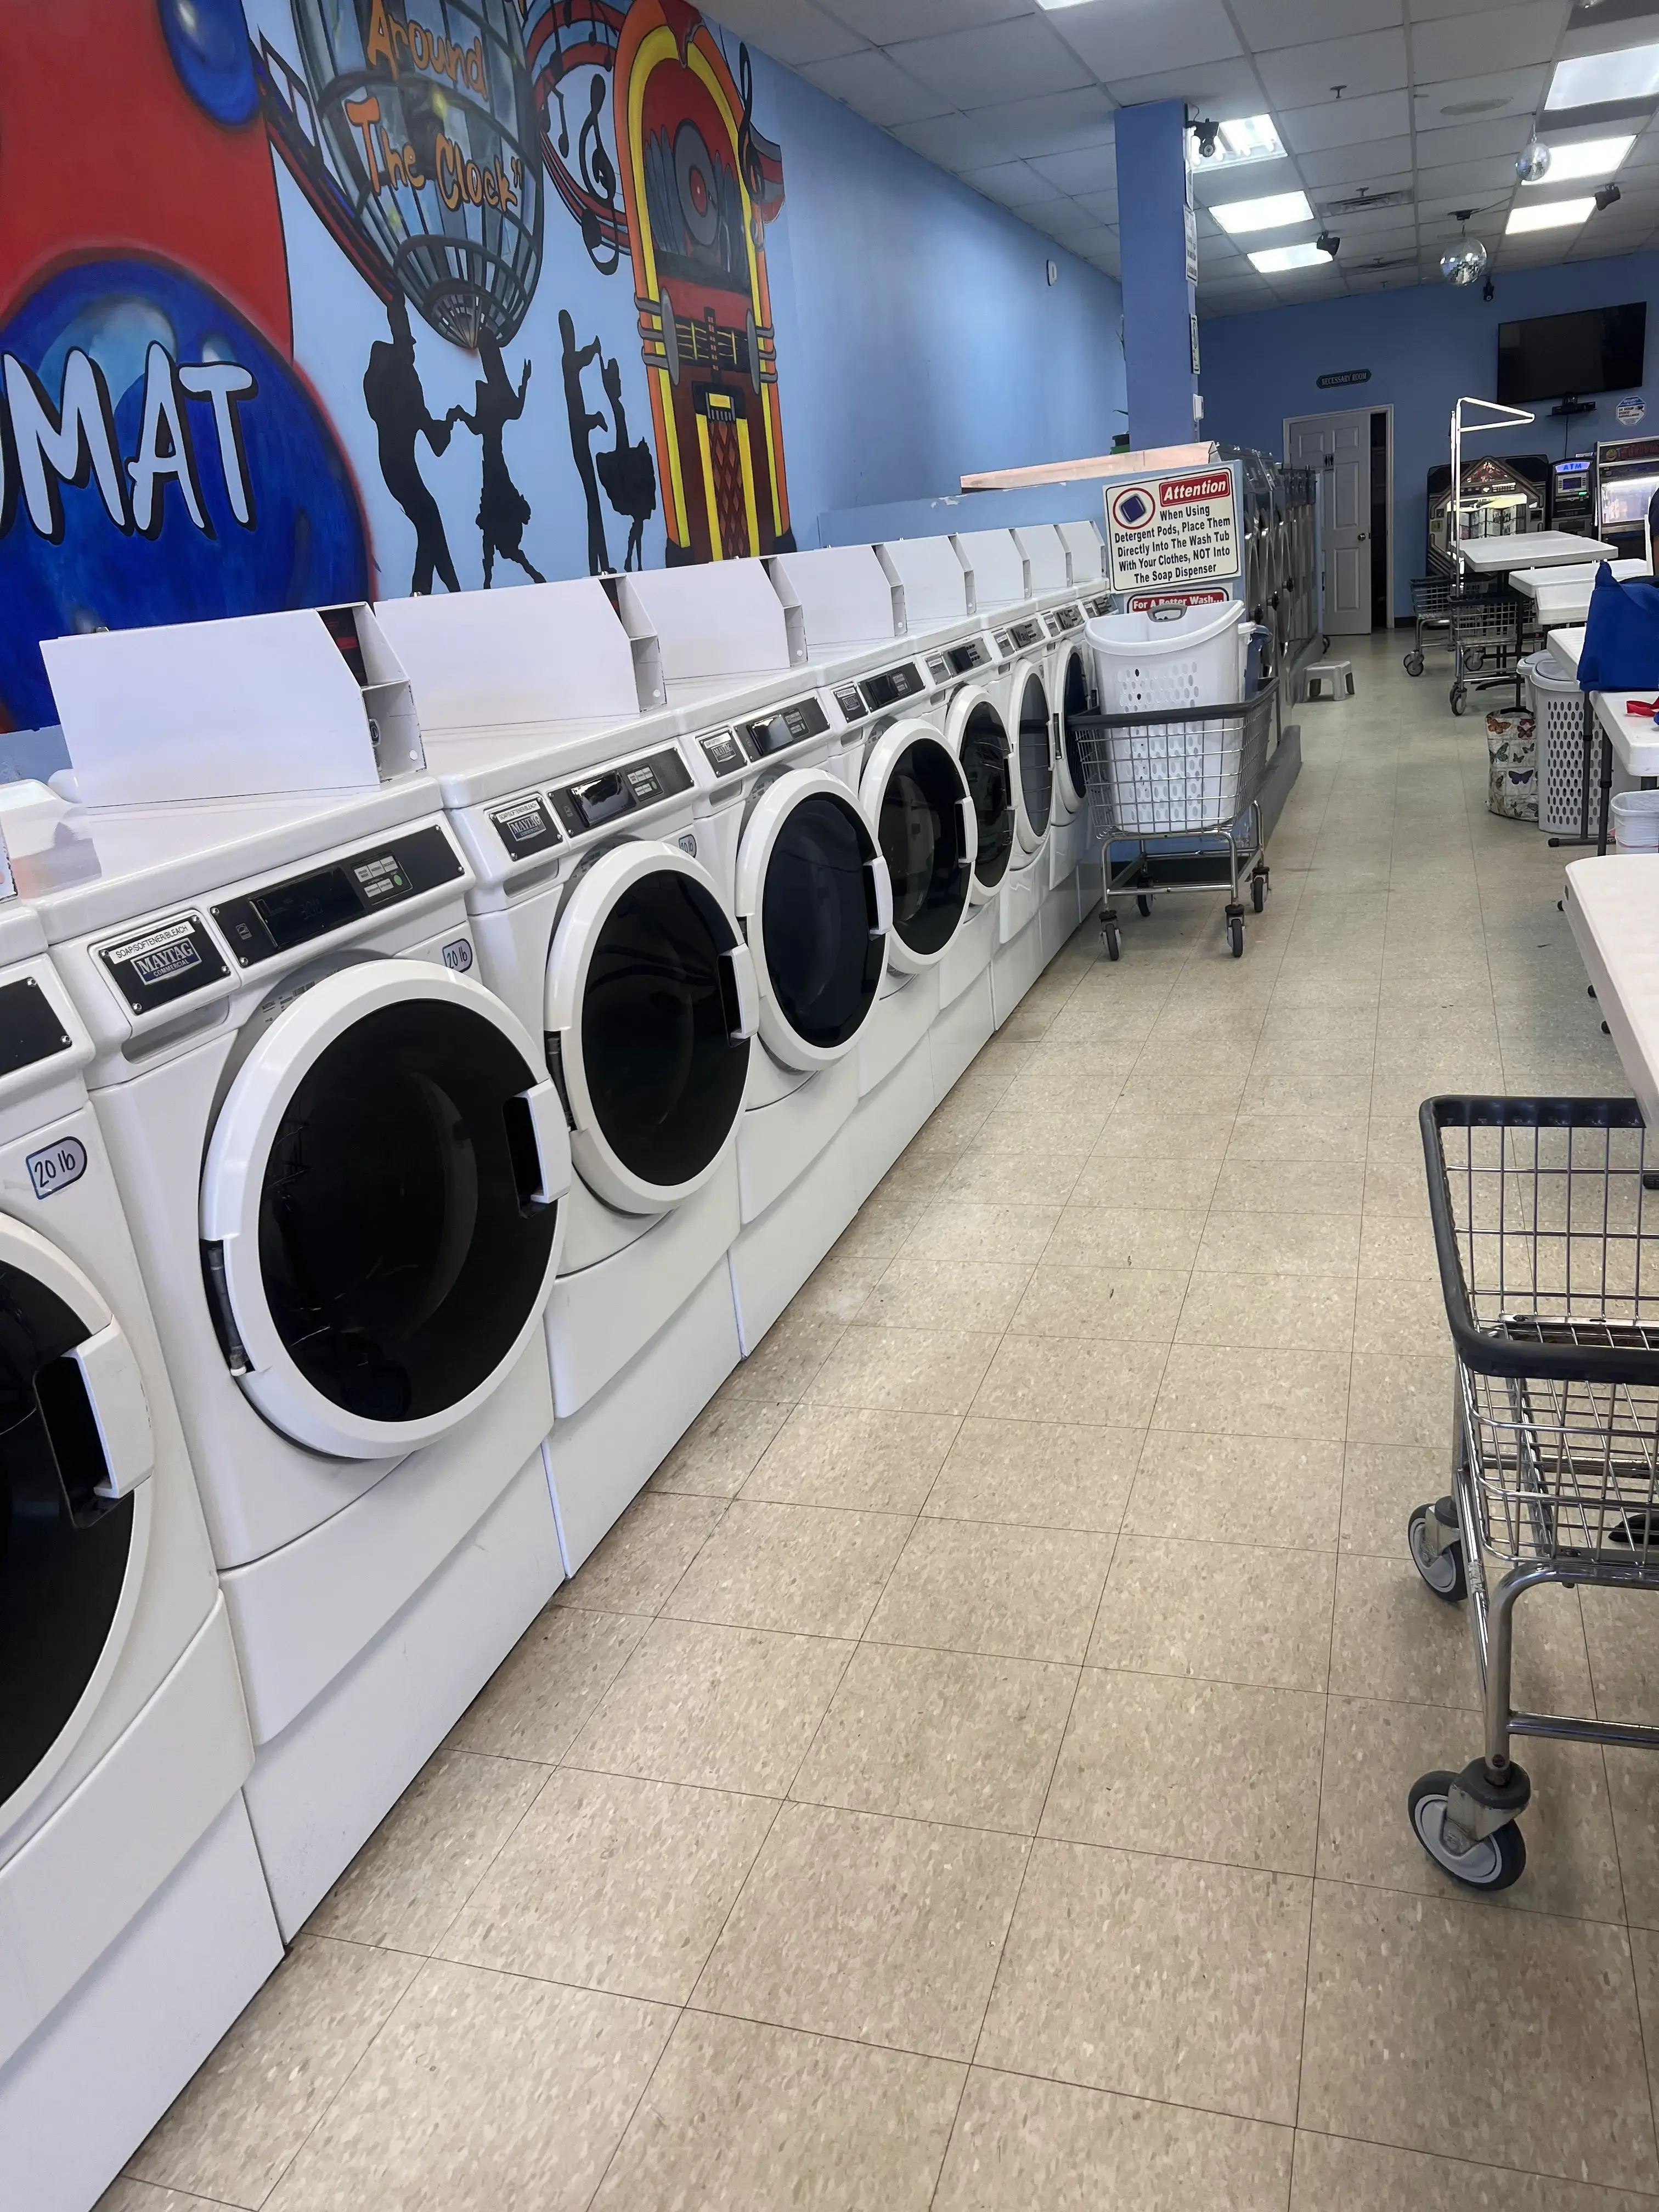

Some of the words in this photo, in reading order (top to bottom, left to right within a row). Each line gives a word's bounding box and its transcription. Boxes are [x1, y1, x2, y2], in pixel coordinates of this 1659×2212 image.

[366, 0, 488, 101] Around
[345, 95, 425, 196] The
[1321, 374, 1352, 385] NECESSARY
[1352, 373, 1367, 381] ROOM
[0, 340, 258, 543] MAT
[1164, 479, 1226, 501] Attention
[1160, 510, 1183, 521] When
[1186, 505, 1210, 517] Using
[1115, 528, 1154, 543] Detergent
[1157, 524, 1180, 537] Pods,
[1182, 522, 1205, 533] Place
[1207, 517, 1230, 528] Them
[1118, 544, 1150, 557] Directly
[1153, 541, 1169, 552] Into
[1171, 538, 1186, 549] The
[1189, 534, 1211, 546] Wash
[1214, 531, 1229, 542] Tub
[1119, 561, 1136, 572] With
[1138, 557, 1156, 568] Your
[1158, 552, 1190, 565] Clothes,
[1193, 548, 1210, 560] NOT
[1214, 546, 1230, 557] Into
[1134, 573, 1150, 584] The
[1153, 570, 1172, 582] Soap
[1175, 563, 1216, 578] Dispenser
[1133, 601, 1148, 609] For
[510, 816, 541, 834] MAYTAG
[116, 925, 188, 959] SOAP/SOFTENER/BLEACH
[137, 943, 194, 975] MAYTAG
[153, 958, 190, 977] COMMERCIAL
[447, 950, 458, 969] 20
[459, 945, 468, 962] lb
[35, 1160, 56, 1188] 20
[57, 1150, 76, 1172] lb
